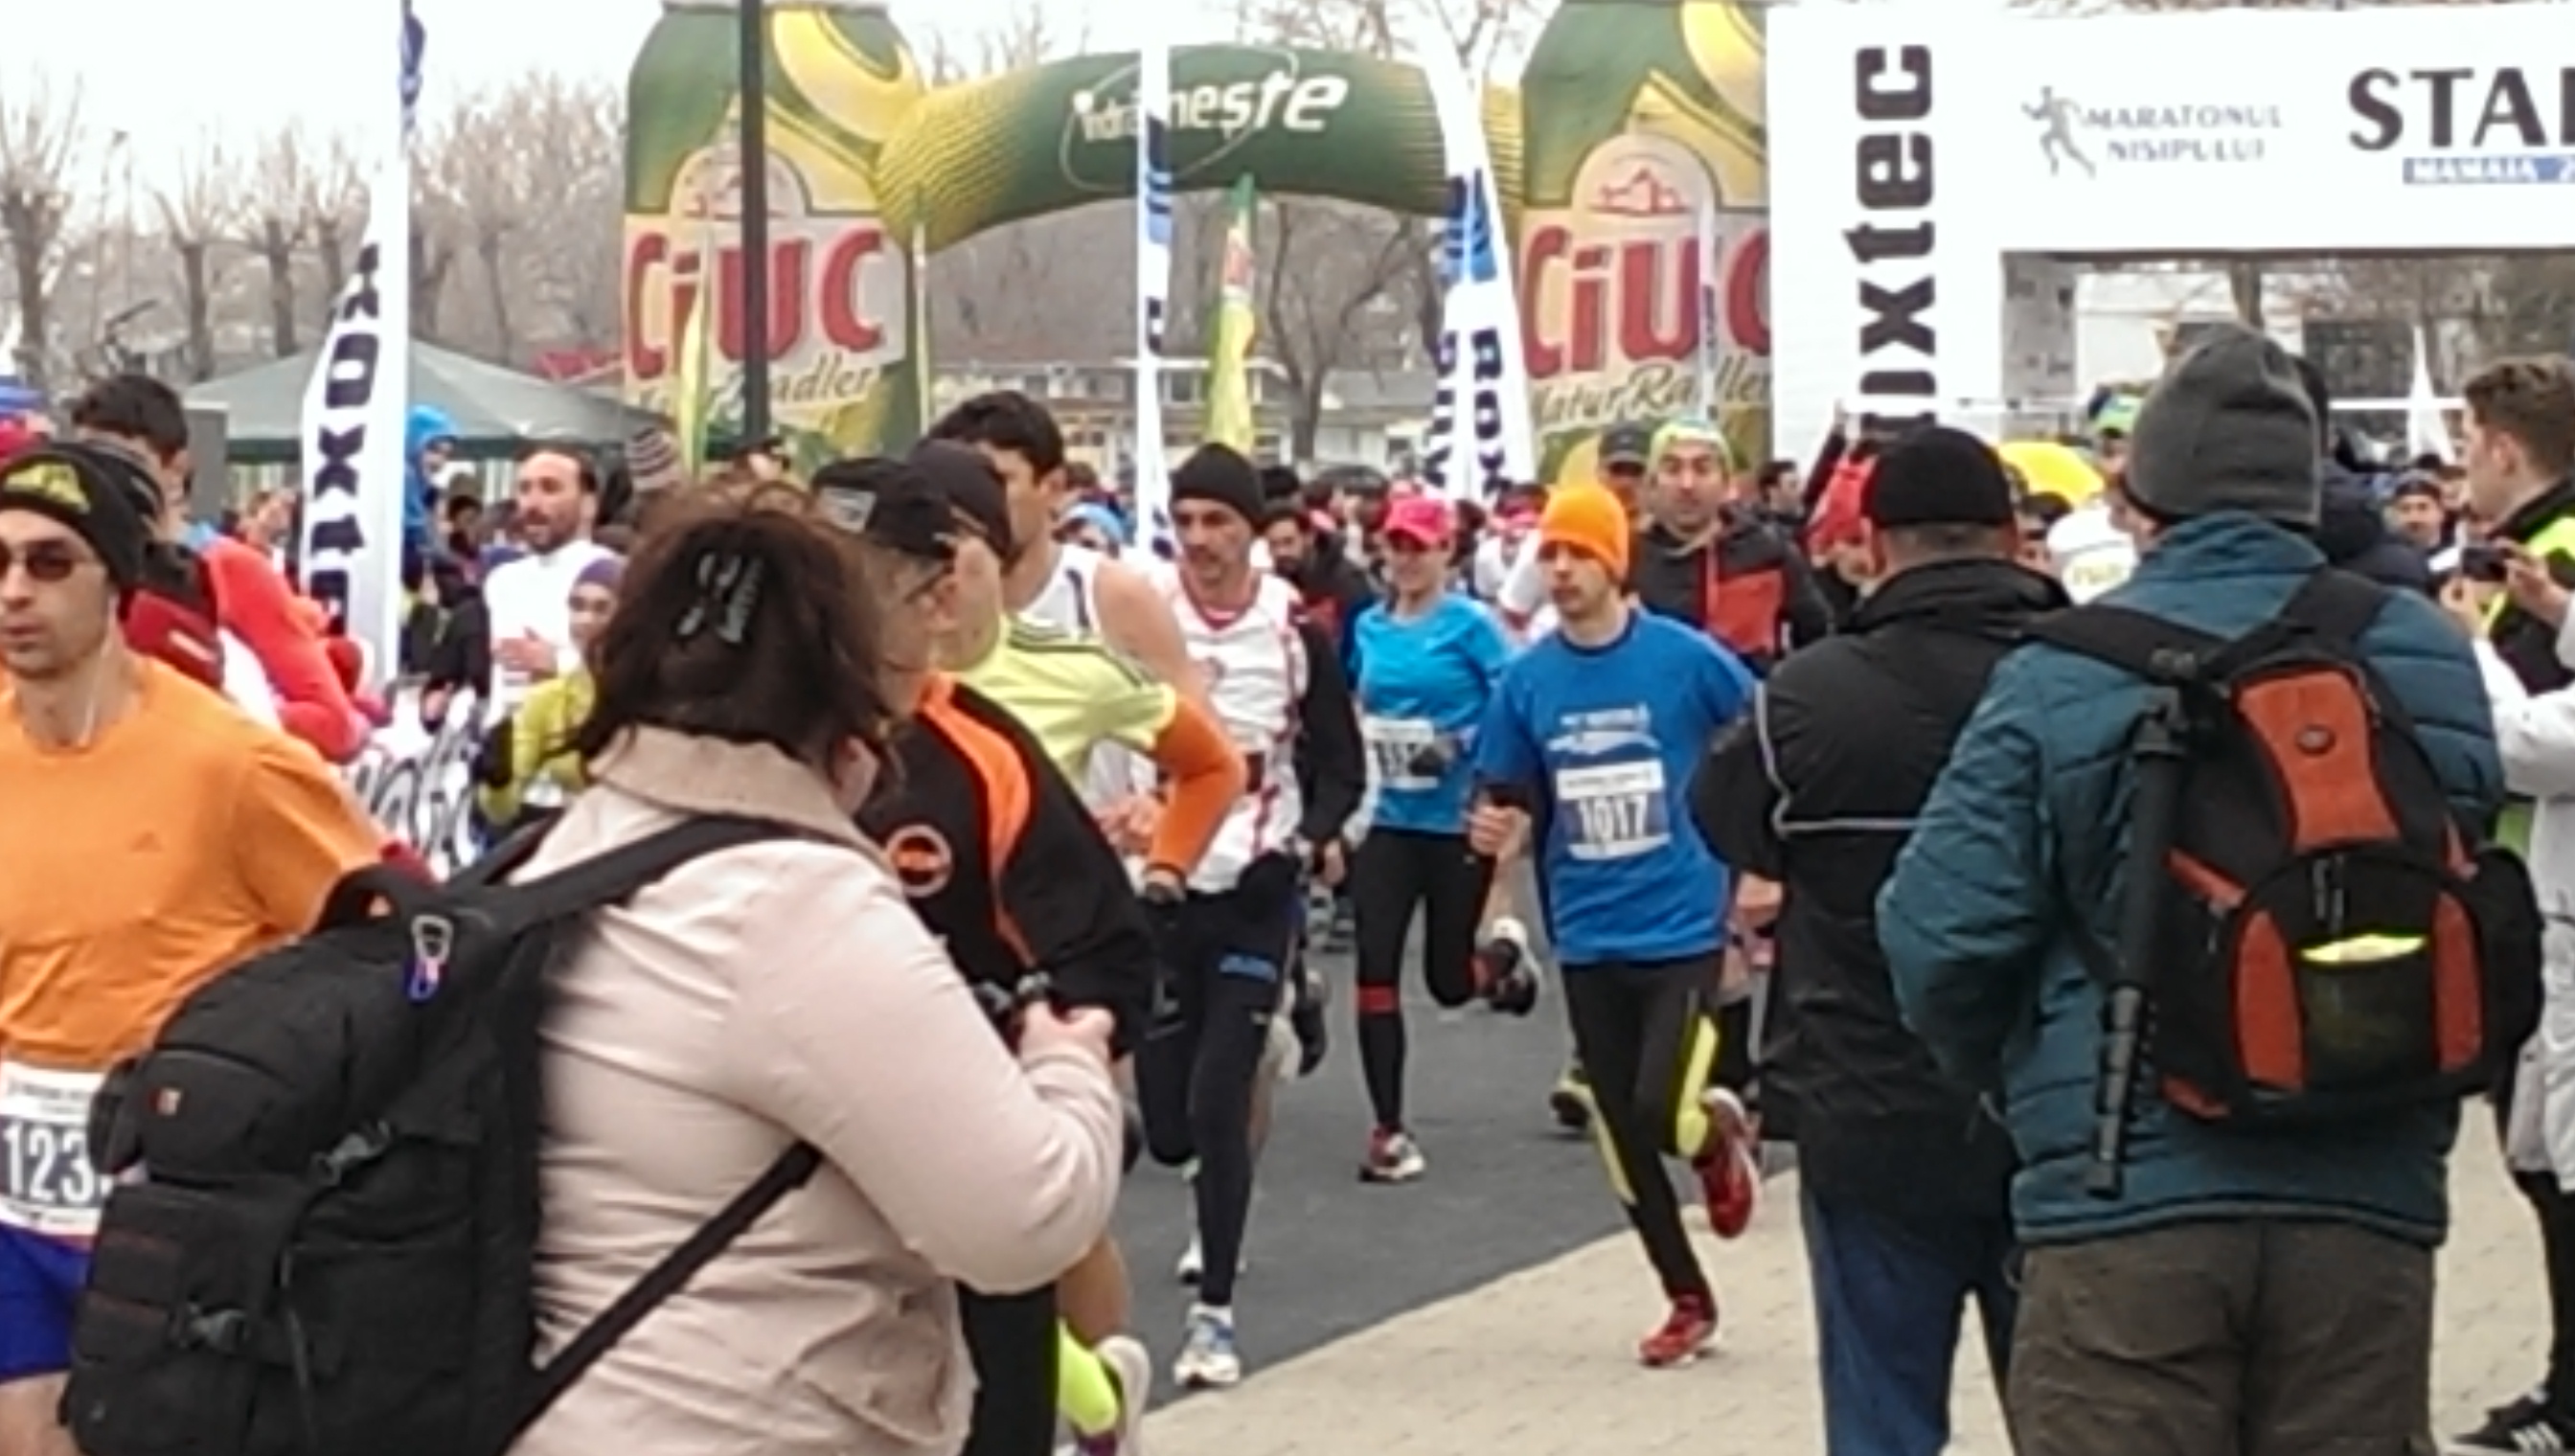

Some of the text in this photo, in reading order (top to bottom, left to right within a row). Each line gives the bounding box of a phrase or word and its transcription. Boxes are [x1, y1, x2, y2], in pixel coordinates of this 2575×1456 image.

[2086, 103, 2282, 131] MARATONUL
[2347, 65, 2575, 152] STA
[2108, 138, 2265, 162] NISIPULUI
[4, 1122, 114, 1204] 123
